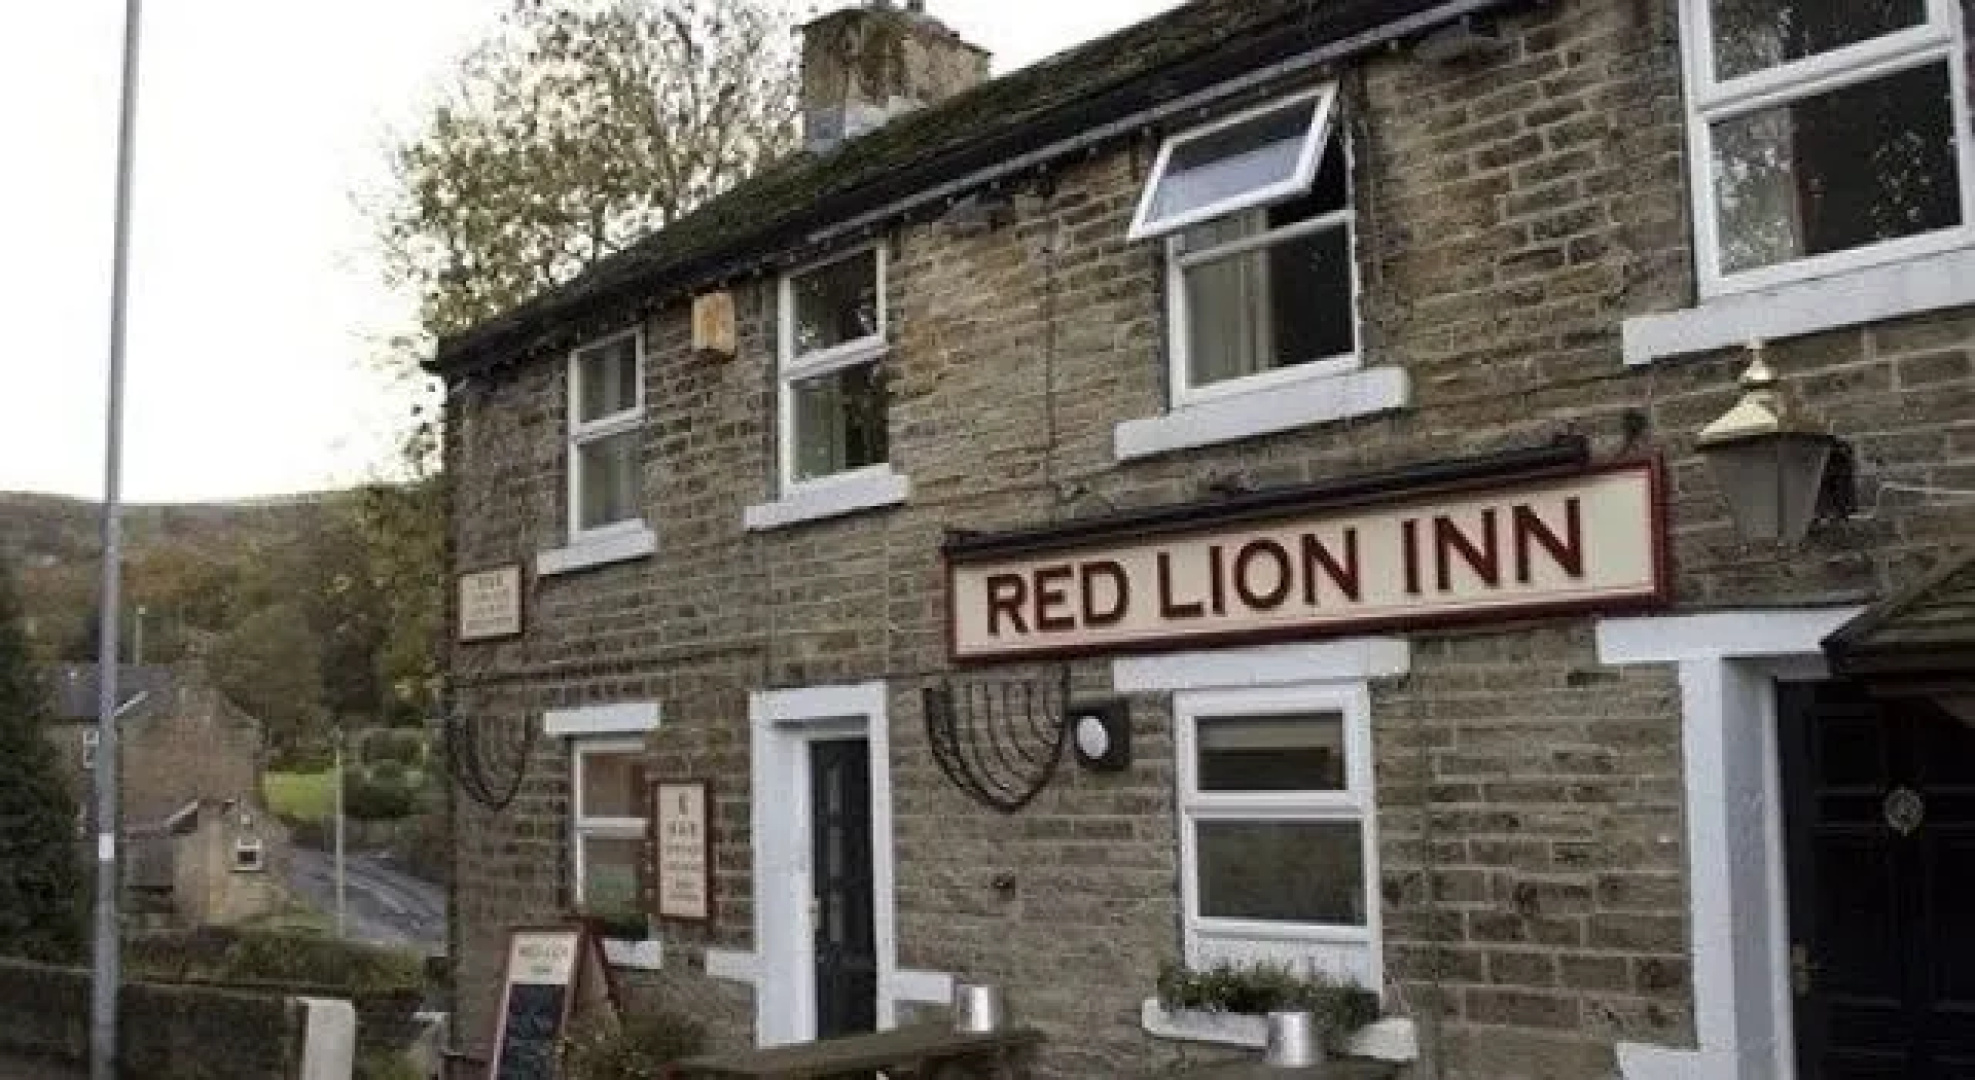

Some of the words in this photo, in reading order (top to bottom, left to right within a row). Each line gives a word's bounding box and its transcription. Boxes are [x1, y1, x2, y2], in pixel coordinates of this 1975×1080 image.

[986, 560, 1130, 634] RED
[1156, 527, 1359, 619] LION
[1402, 497, 1584, 596] INN
